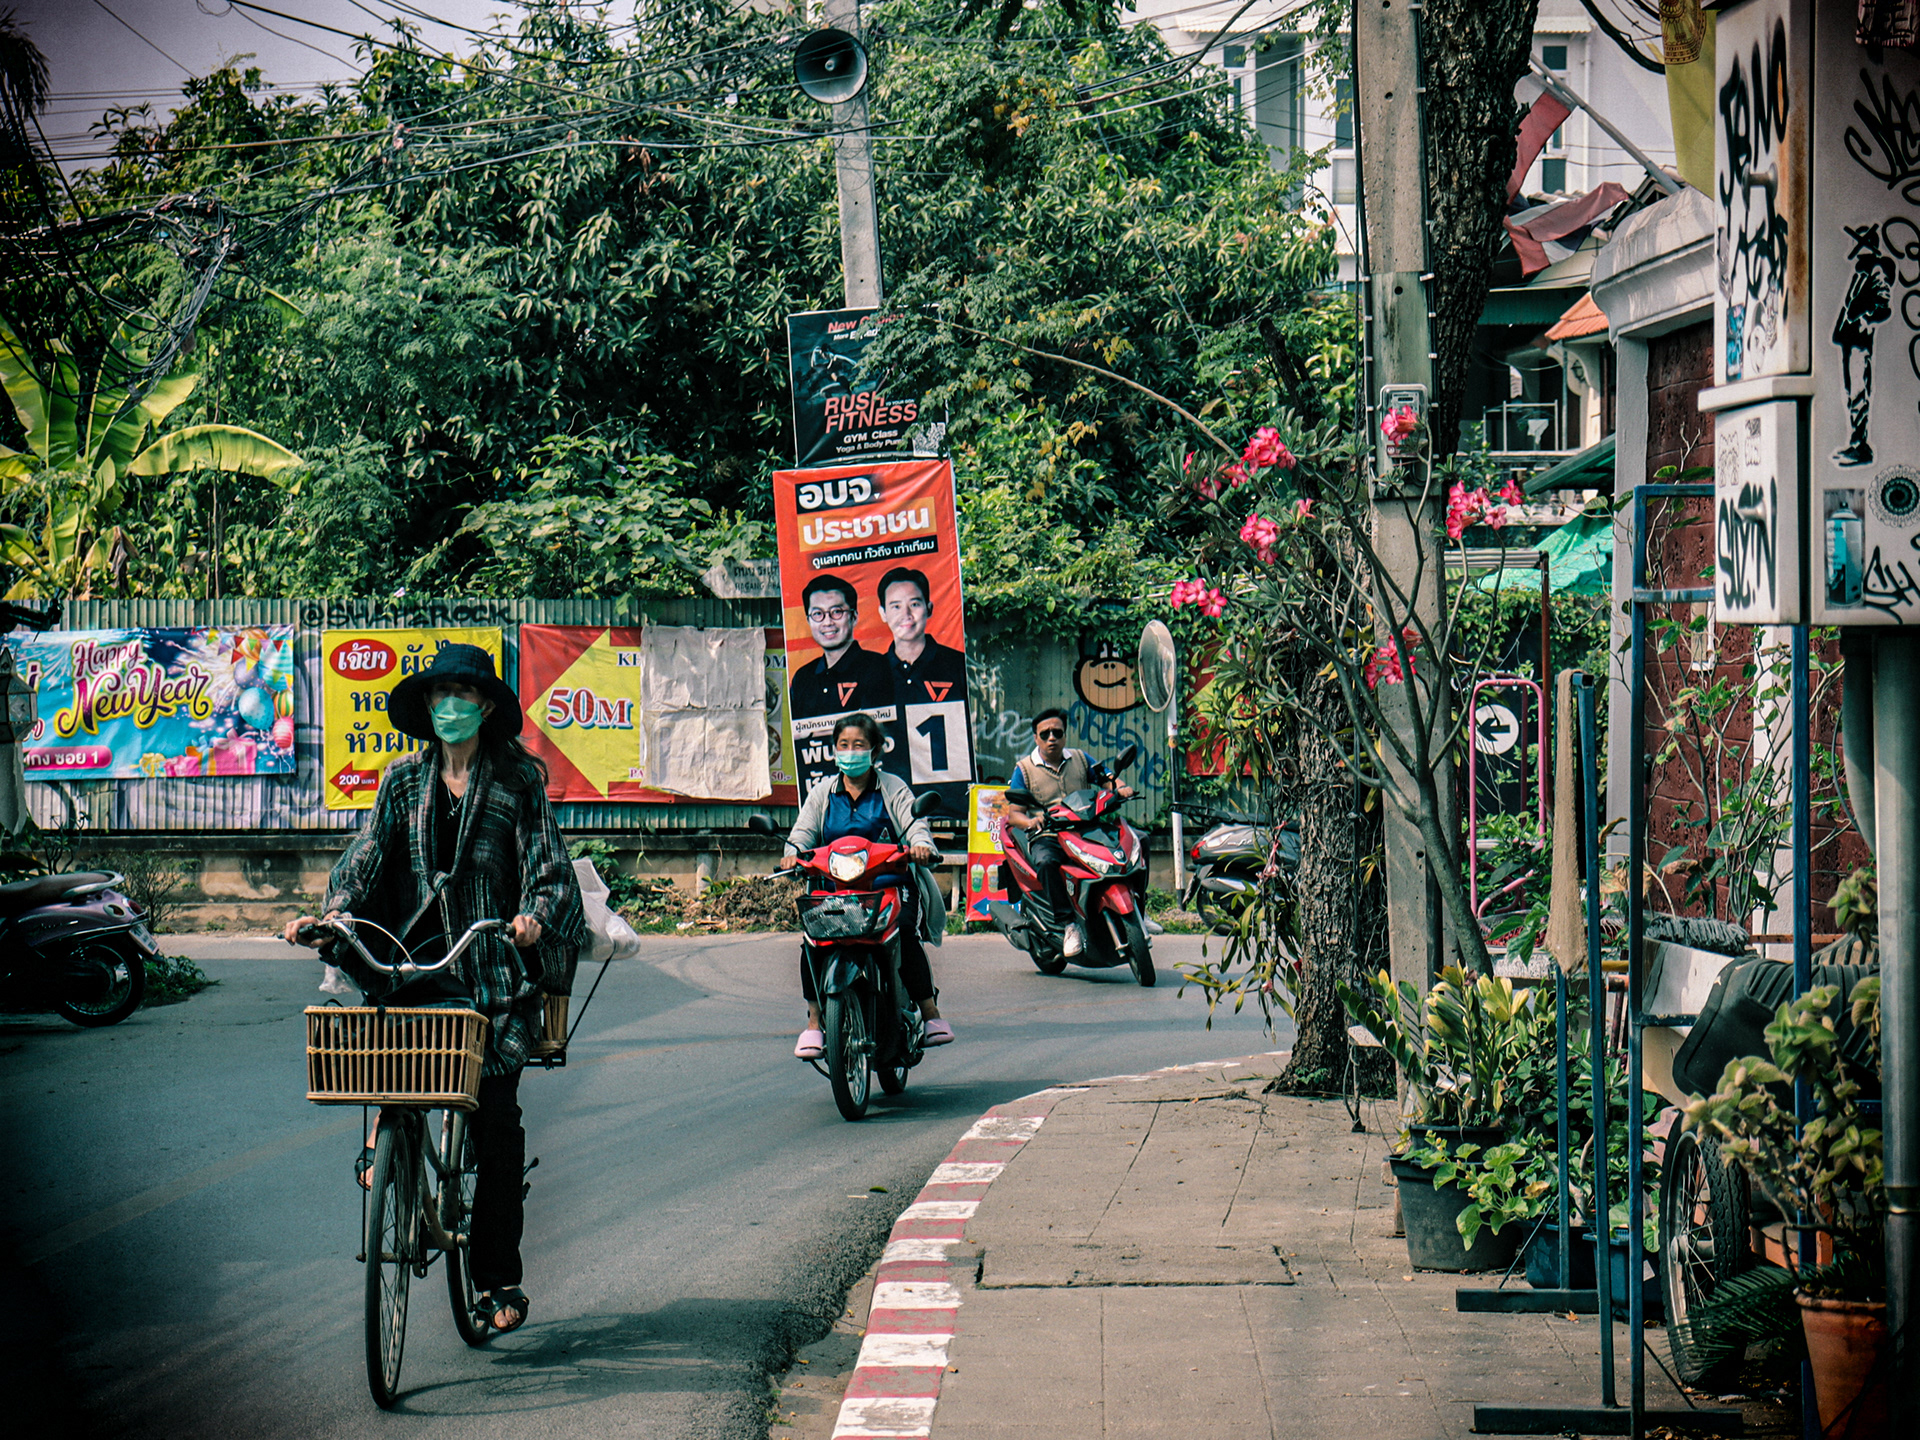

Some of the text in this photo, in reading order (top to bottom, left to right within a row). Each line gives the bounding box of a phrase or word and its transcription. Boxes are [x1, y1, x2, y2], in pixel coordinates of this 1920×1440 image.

[827, 320, 857, 334] New
[824, 391, 885, 417] RUSH
[825, 403, 918, 434] FITNESS
[836, 445, 856, 453] Yoga
[864, 440, 884, 449] Body
[843, 428, 898, 444] GYM Class
[802, 507, 930, 546] ประชาชน
[812, 551, 863, 570] ดูแลทุกคน
[75, 642, 144, 676] Happy
[57, 672, 136, 735] New
[127, 665, 209, 725] Year
[916, 714, 948, 771] 1
[54, 751, 86, 766] ซอย
[91, 750, 99, 765] 1
[339, 774, 361, 786] 200
